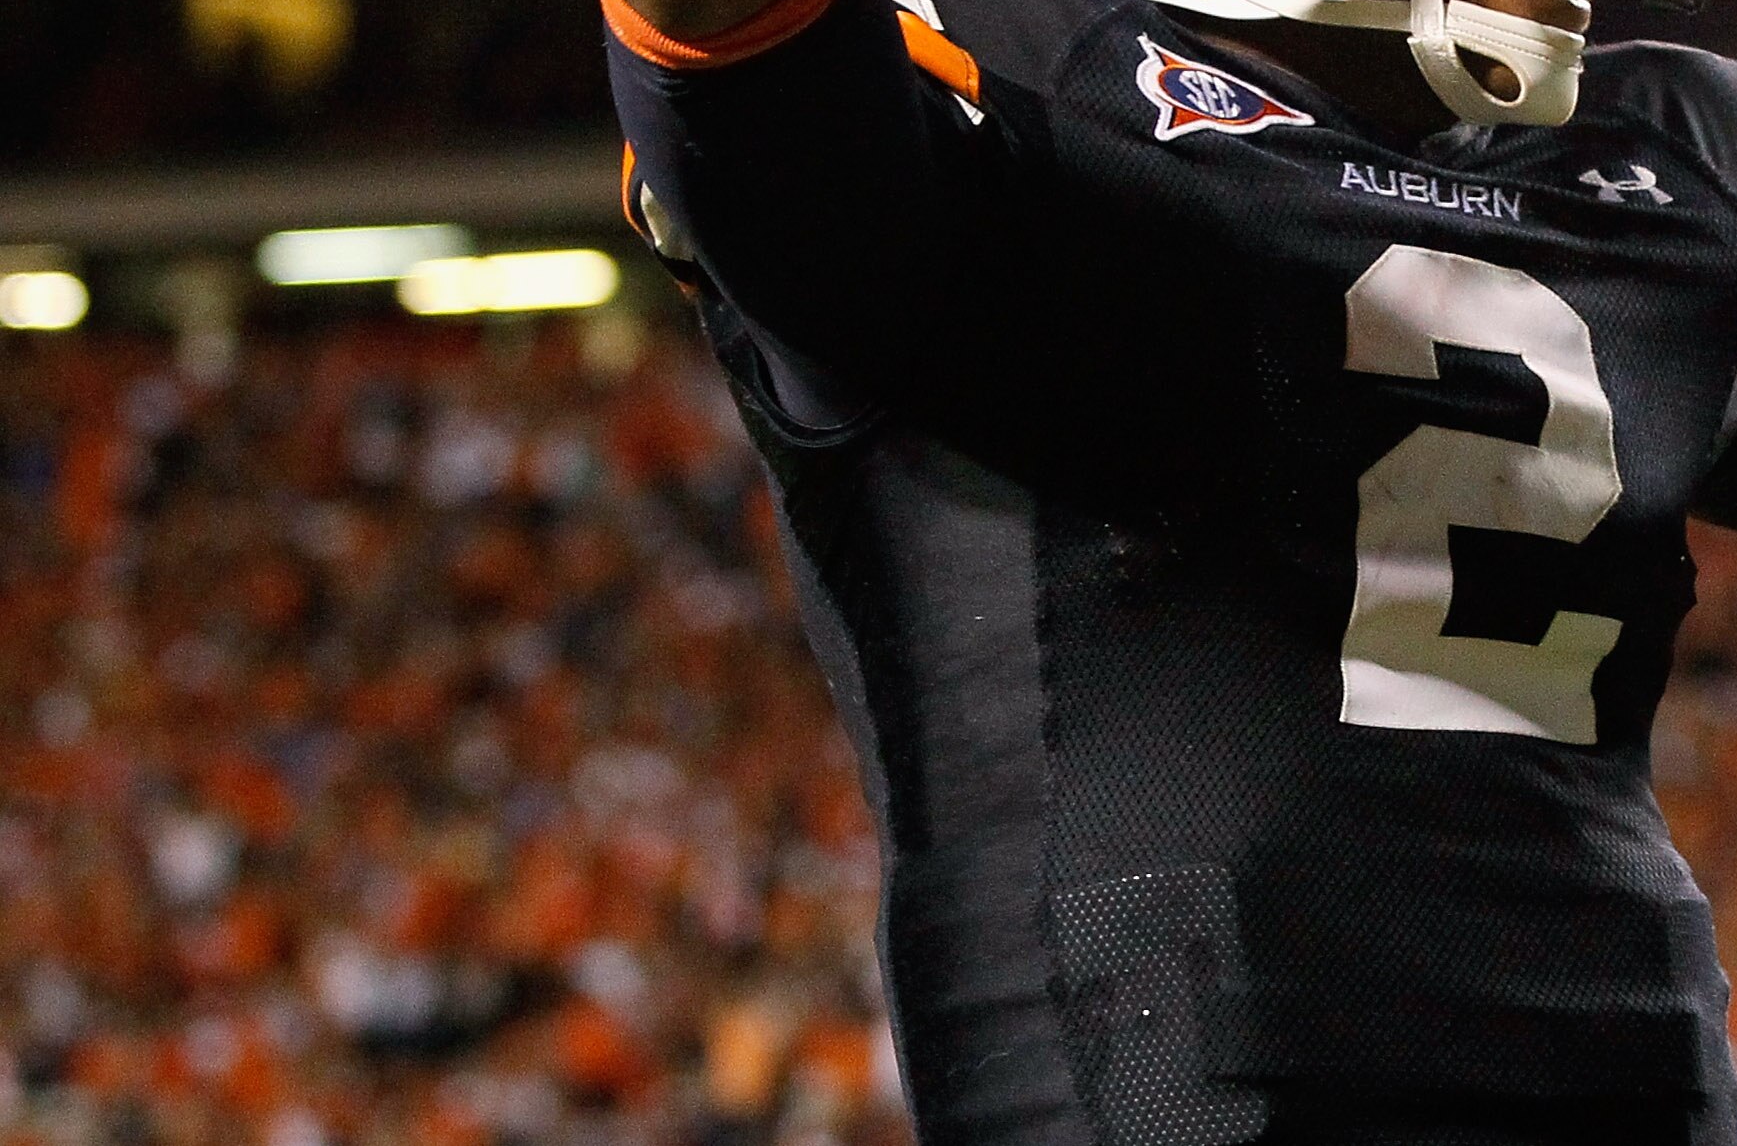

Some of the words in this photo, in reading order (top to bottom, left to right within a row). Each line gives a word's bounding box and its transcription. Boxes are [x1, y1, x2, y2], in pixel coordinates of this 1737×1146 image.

[1178, 70, 1242, 119] SEC
[1340, 162, 1522, 222] AUBURN
[1339, 243, 1624, 745] 2
